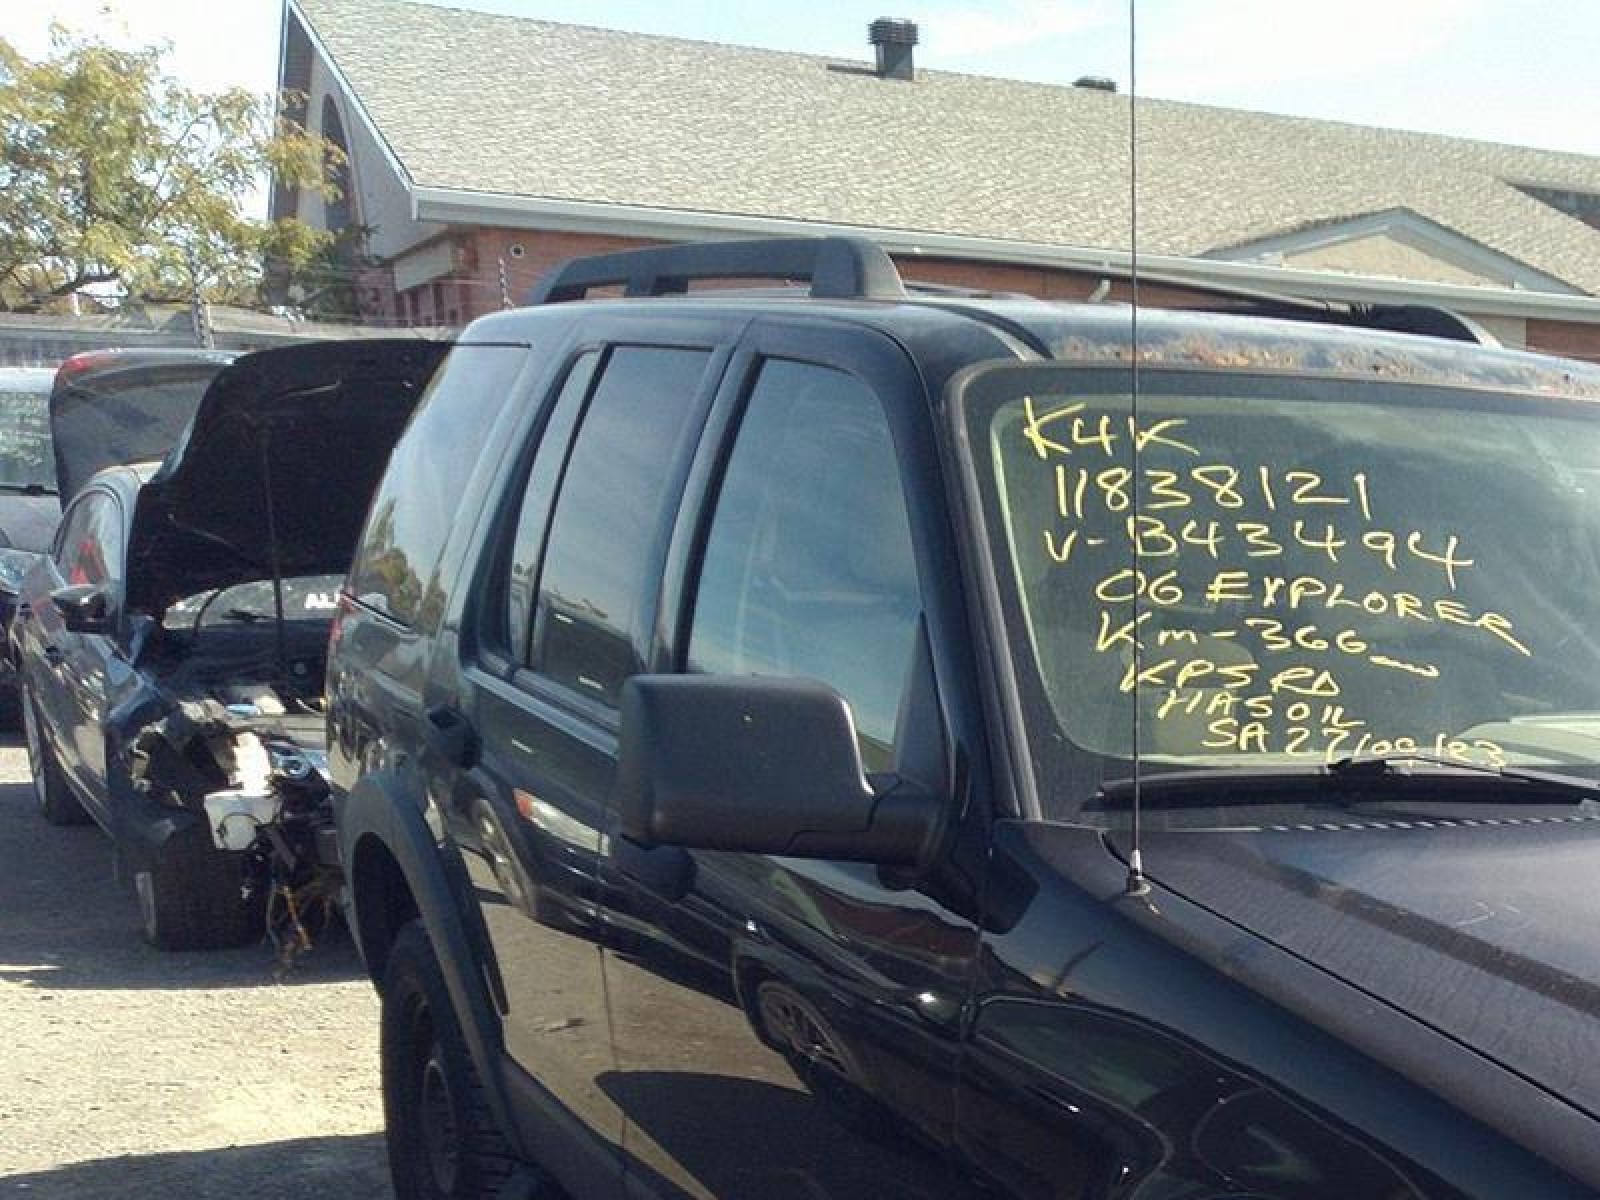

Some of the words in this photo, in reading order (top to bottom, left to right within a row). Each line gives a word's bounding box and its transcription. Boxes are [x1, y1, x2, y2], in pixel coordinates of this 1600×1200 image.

[1055, 464, 1372, 521] 11838121
[1095, 569, 1184, 605] 06
[1205, 571, 1533, 656] EXPLORER
[1157, 688, 1274, 720] HAS
[1286, 701, 1366, 729] OIL
